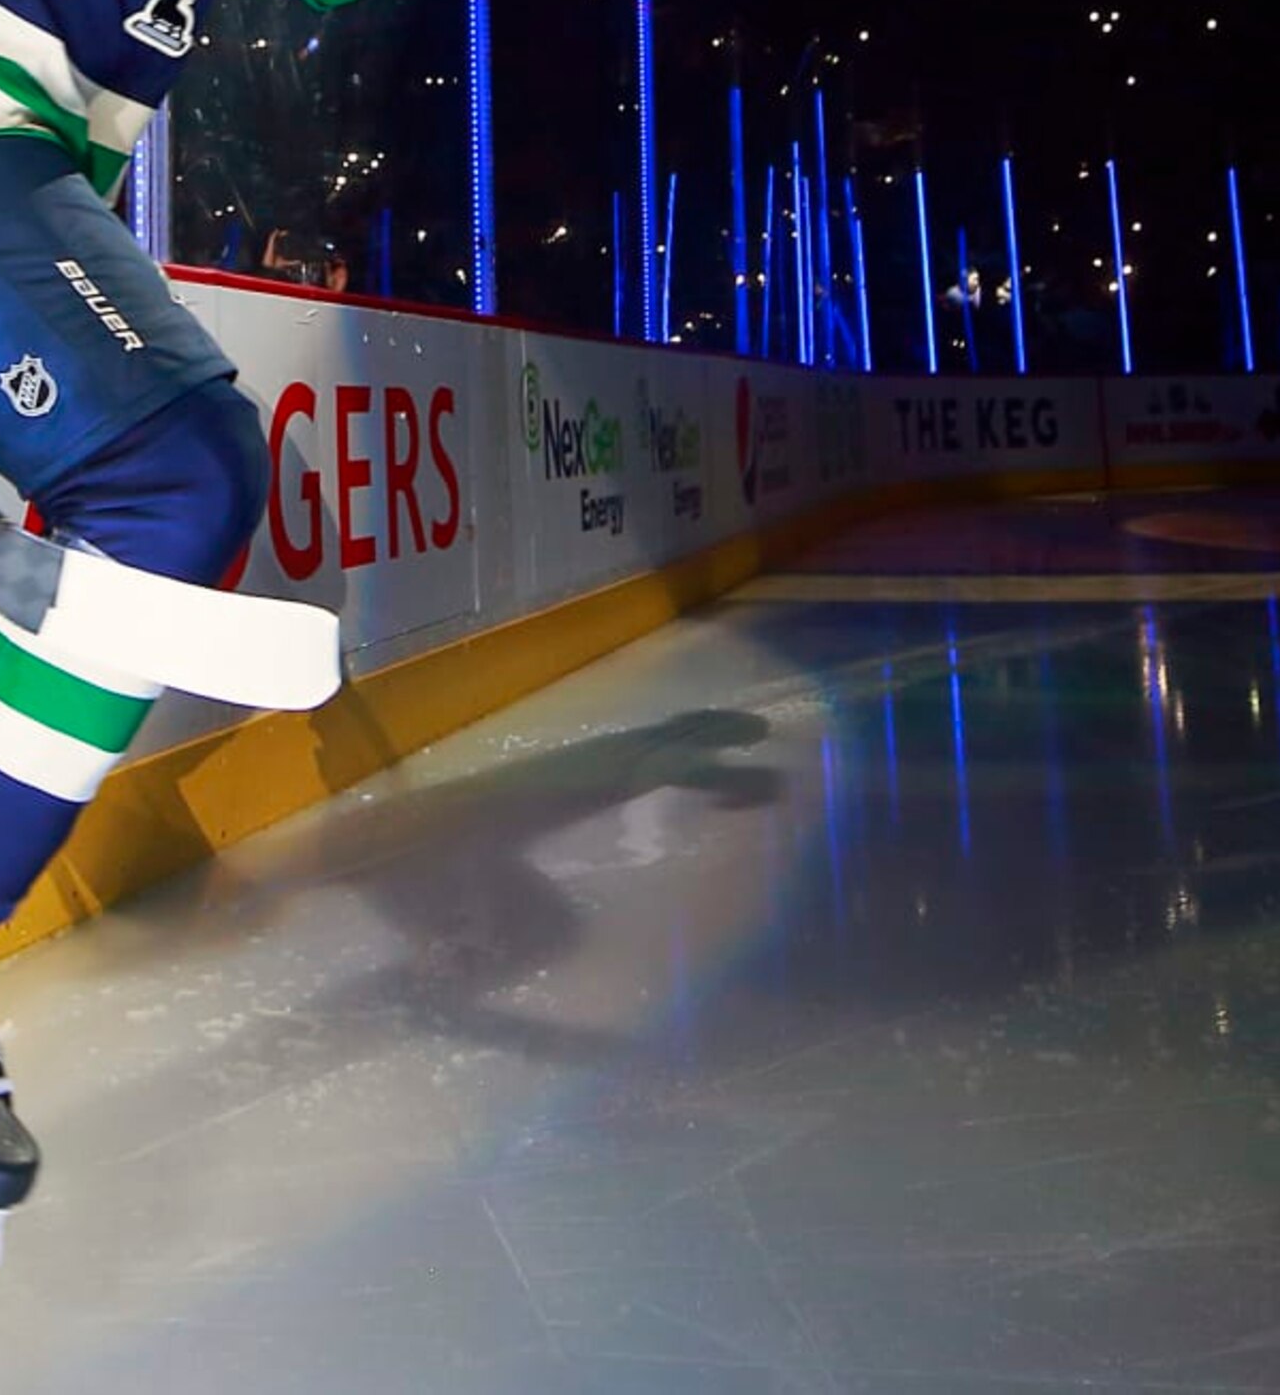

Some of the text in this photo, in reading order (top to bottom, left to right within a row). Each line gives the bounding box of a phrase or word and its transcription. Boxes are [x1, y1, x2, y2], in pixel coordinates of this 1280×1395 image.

[54, 259, 144, 352] BAUER
[893, 398, 961, 451] THE
[976, 398, 1058, 448] KEG
